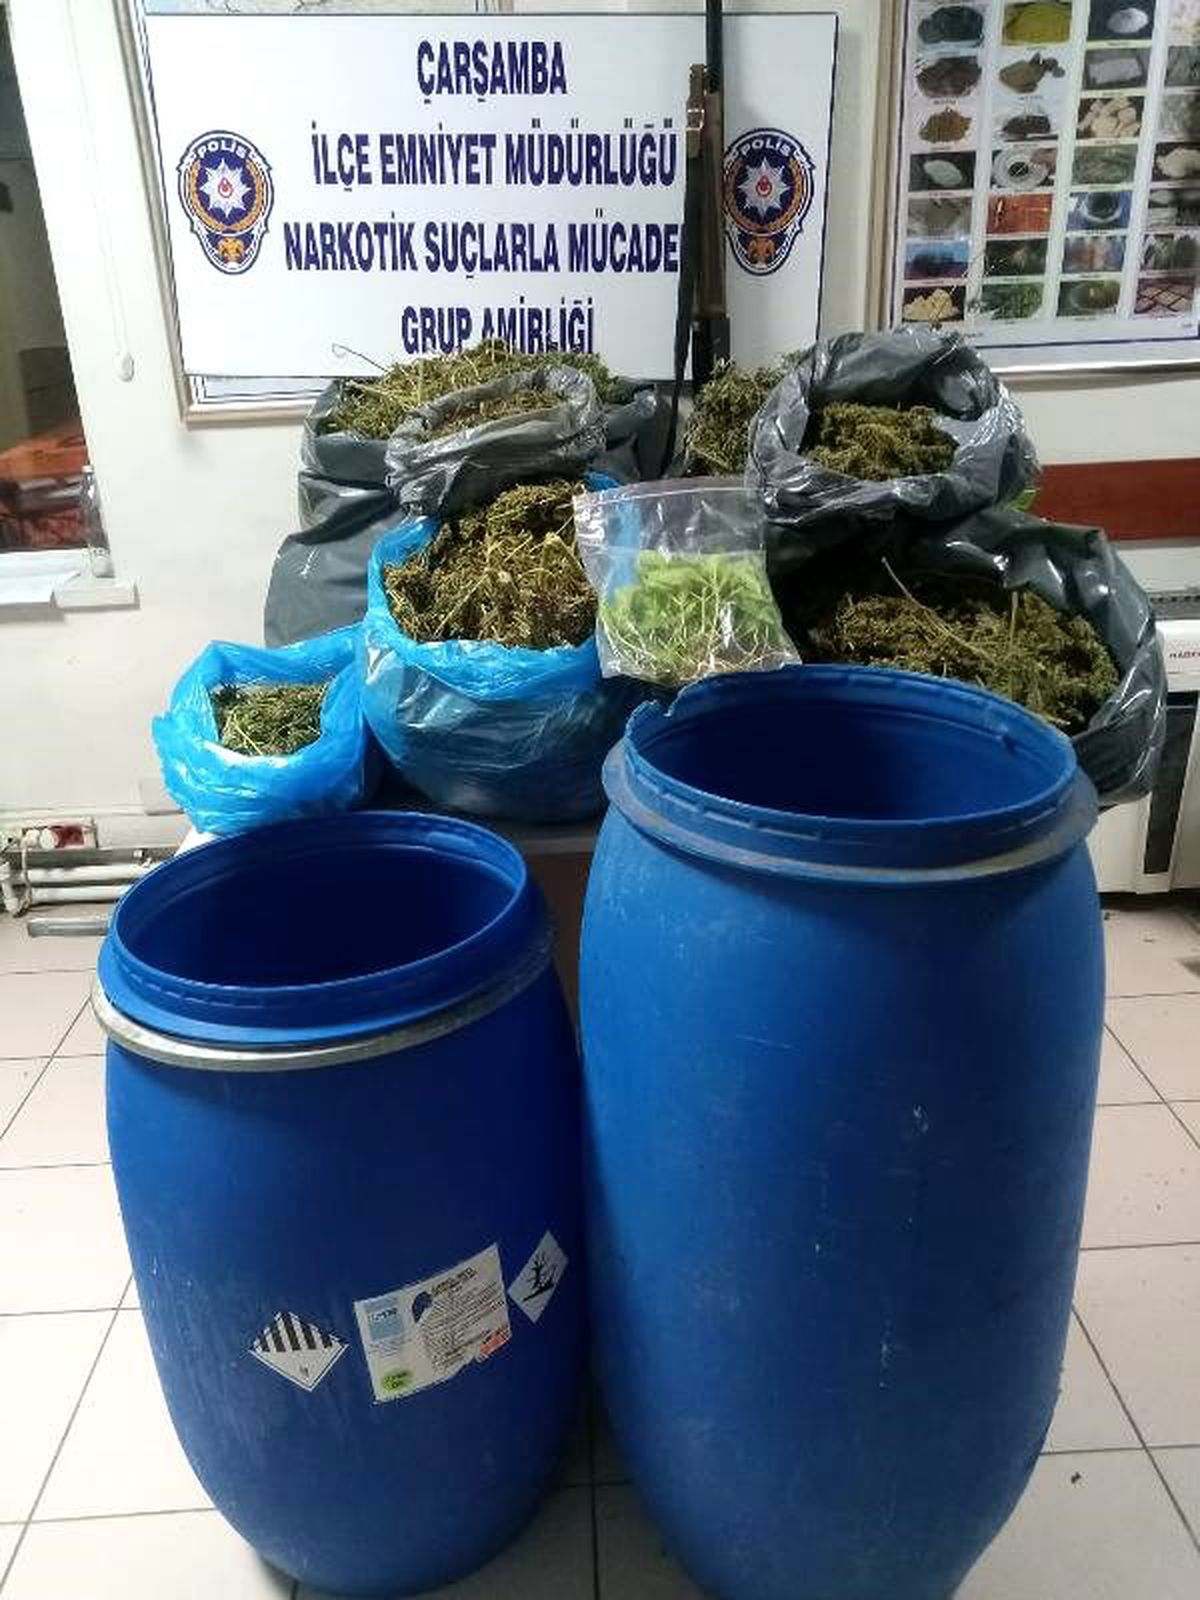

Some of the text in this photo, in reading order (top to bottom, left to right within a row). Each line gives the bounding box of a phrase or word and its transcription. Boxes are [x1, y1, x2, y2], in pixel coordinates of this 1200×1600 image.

[417, 40, 567, 104] ÇARŞAMBA
[312, 117, 677, 192] İLÇE EMNİYET MÜDÜRLÜĞÜ
[283, 211, 418, 272] NARKOTİK
[424, 221, 560, 279] SUÇLARLA
[401, 296, 594, 354] GRUP AMİRLİĞİ
